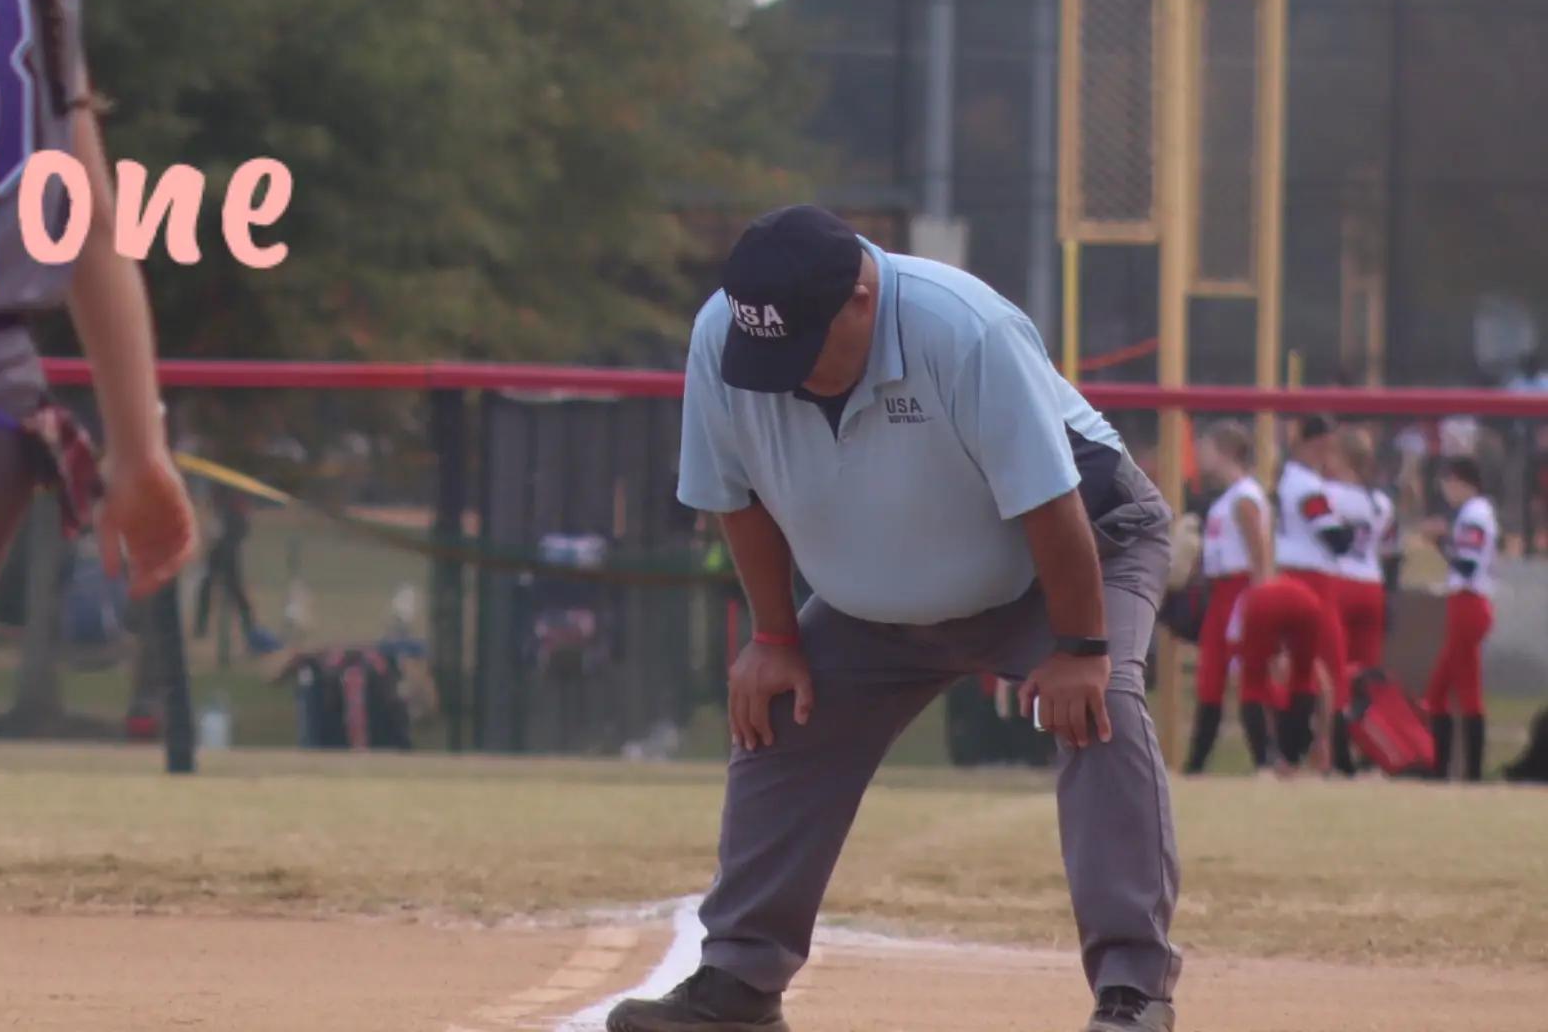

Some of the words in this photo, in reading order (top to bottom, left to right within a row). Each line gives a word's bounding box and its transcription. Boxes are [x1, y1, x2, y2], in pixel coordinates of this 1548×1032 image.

[728, 294, 784, 327] USA
[735, 318, 788, 338] TBALL
[884, 397, 924, 414] USA
